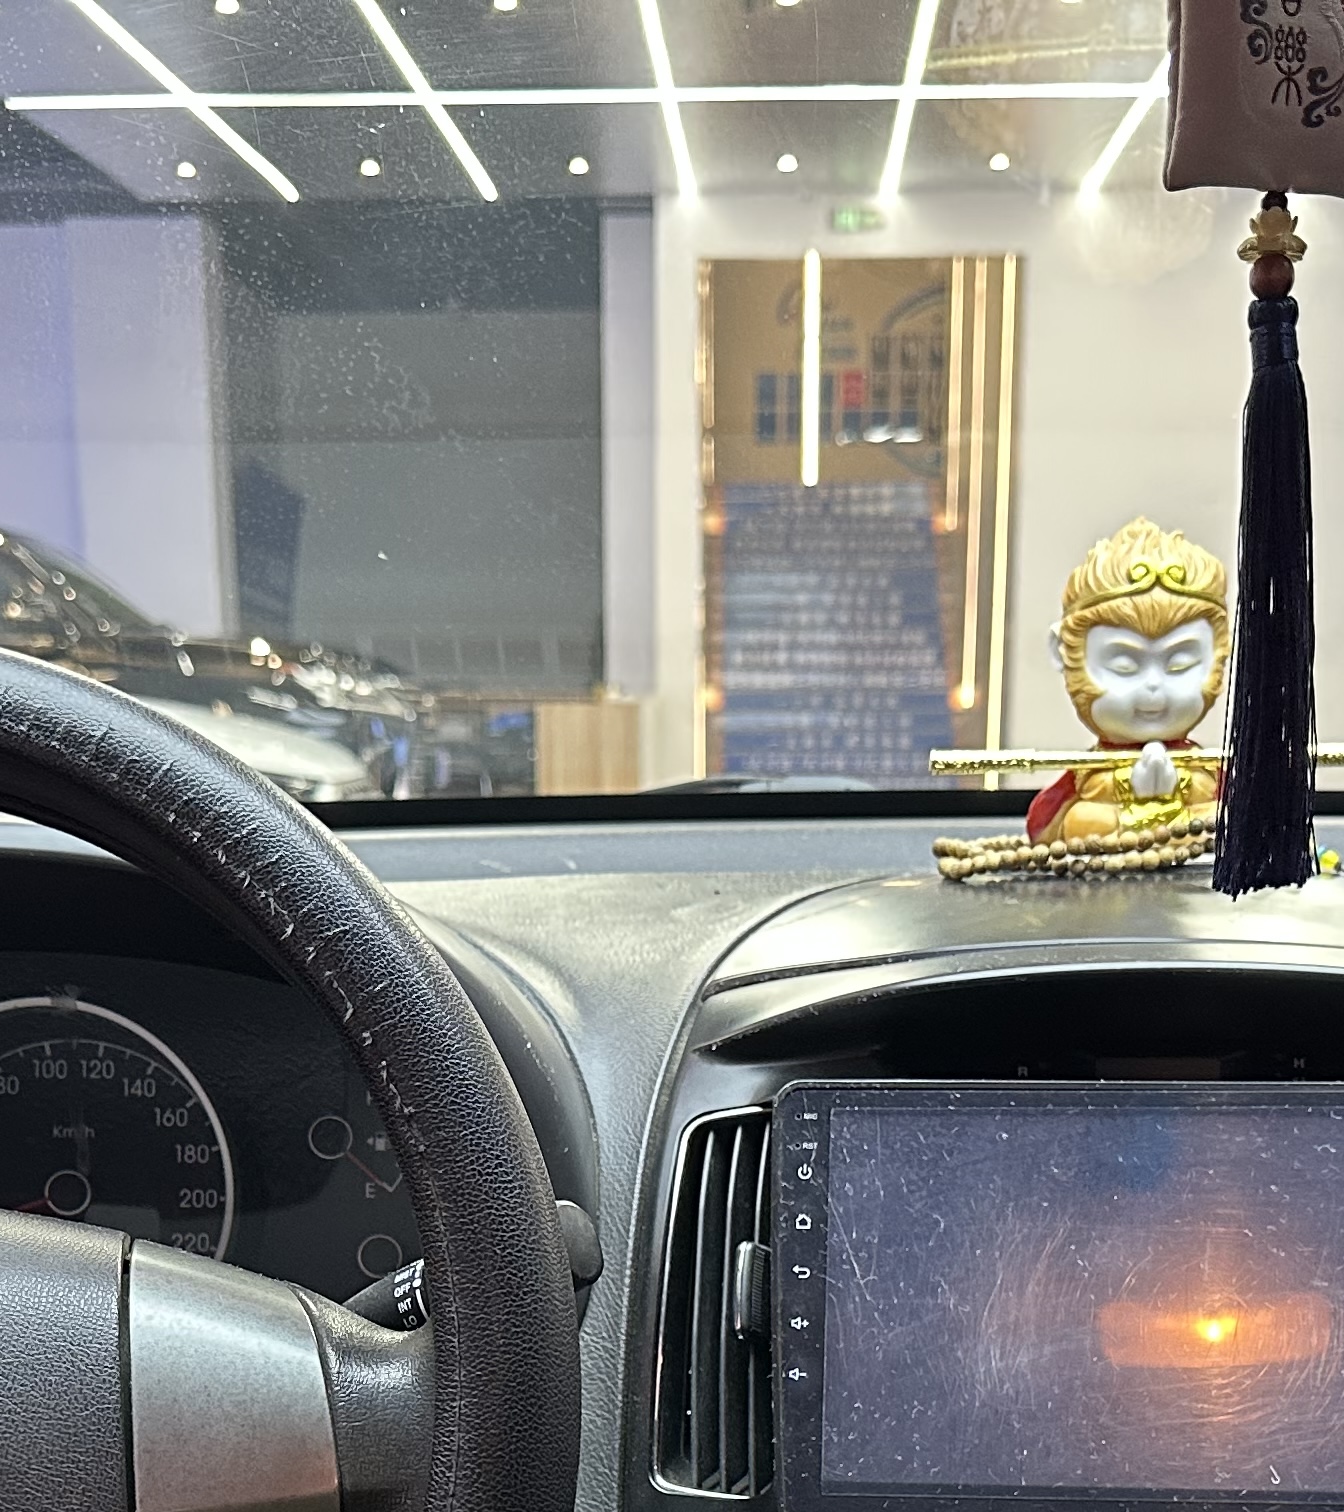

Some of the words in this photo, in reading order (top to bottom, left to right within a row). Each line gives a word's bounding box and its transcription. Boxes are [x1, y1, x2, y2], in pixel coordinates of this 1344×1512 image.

[32, 1059, 68, 1080] 100
[80, 1059, 115, 1080] 120
[122, 1077, 156, 1098] 140
[154, 1106, 188, 1128] 160
[52, 1124, 96, 1139] Kmh
[174, 1143, 210, 1164] 180
[178, 1188, 218, 1209] 200
[365, 1182, 376, 1199] E
[171, 1232, 210, 1252] 220
[393, 1281, 412, 1298] OFF
[397, 1297, 412, 1314] INT
[403, 1315, 418, 1329] LO
